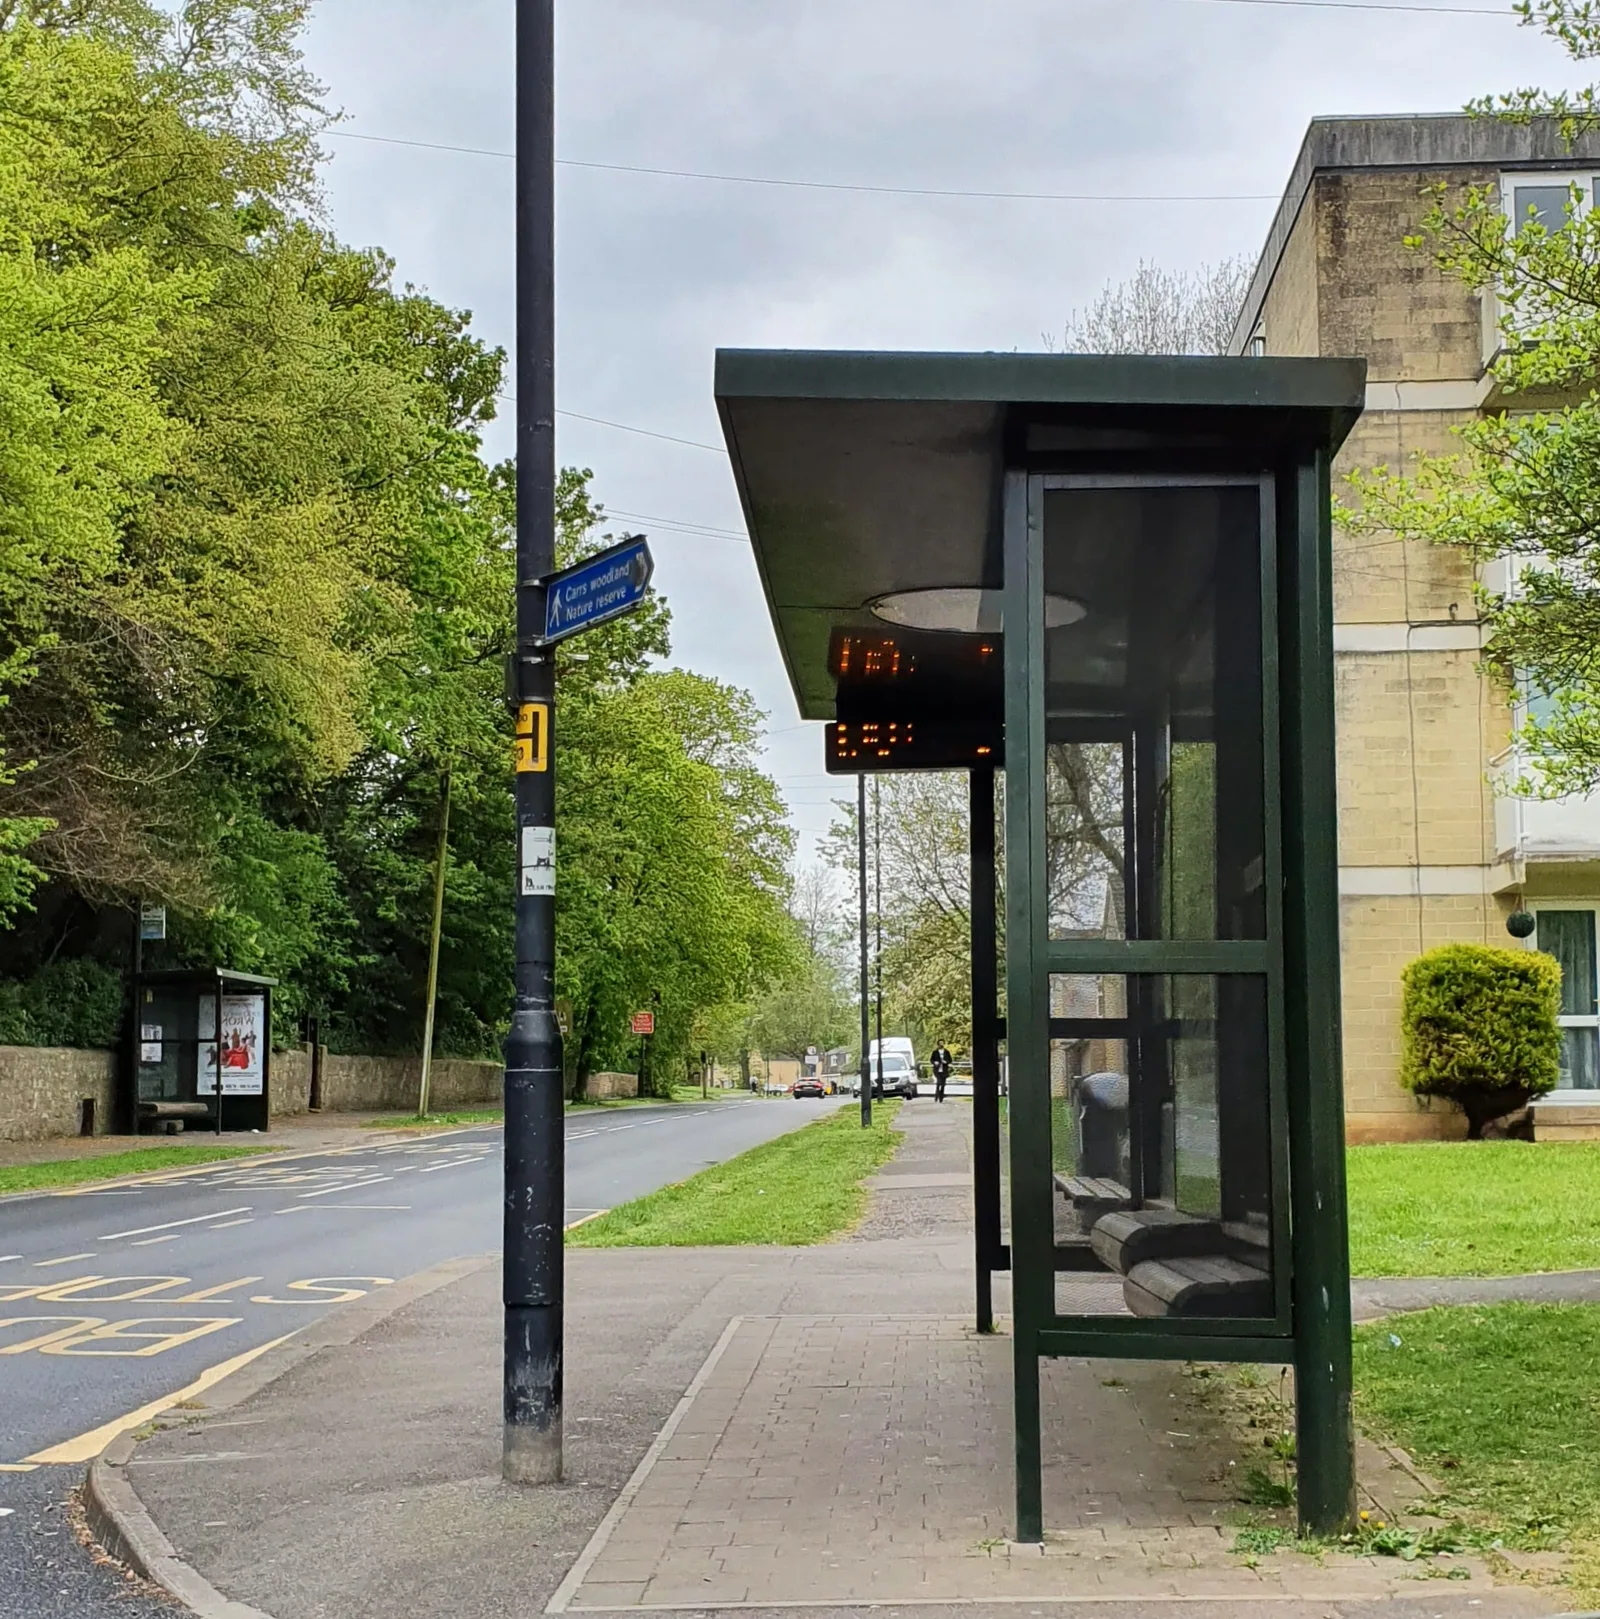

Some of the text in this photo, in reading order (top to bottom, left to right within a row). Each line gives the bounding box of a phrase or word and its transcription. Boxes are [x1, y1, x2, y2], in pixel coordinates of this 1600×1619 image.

[565, 562, 630, 602] Carrs woodland
[565, 587, 627, 622] Nature reserve
